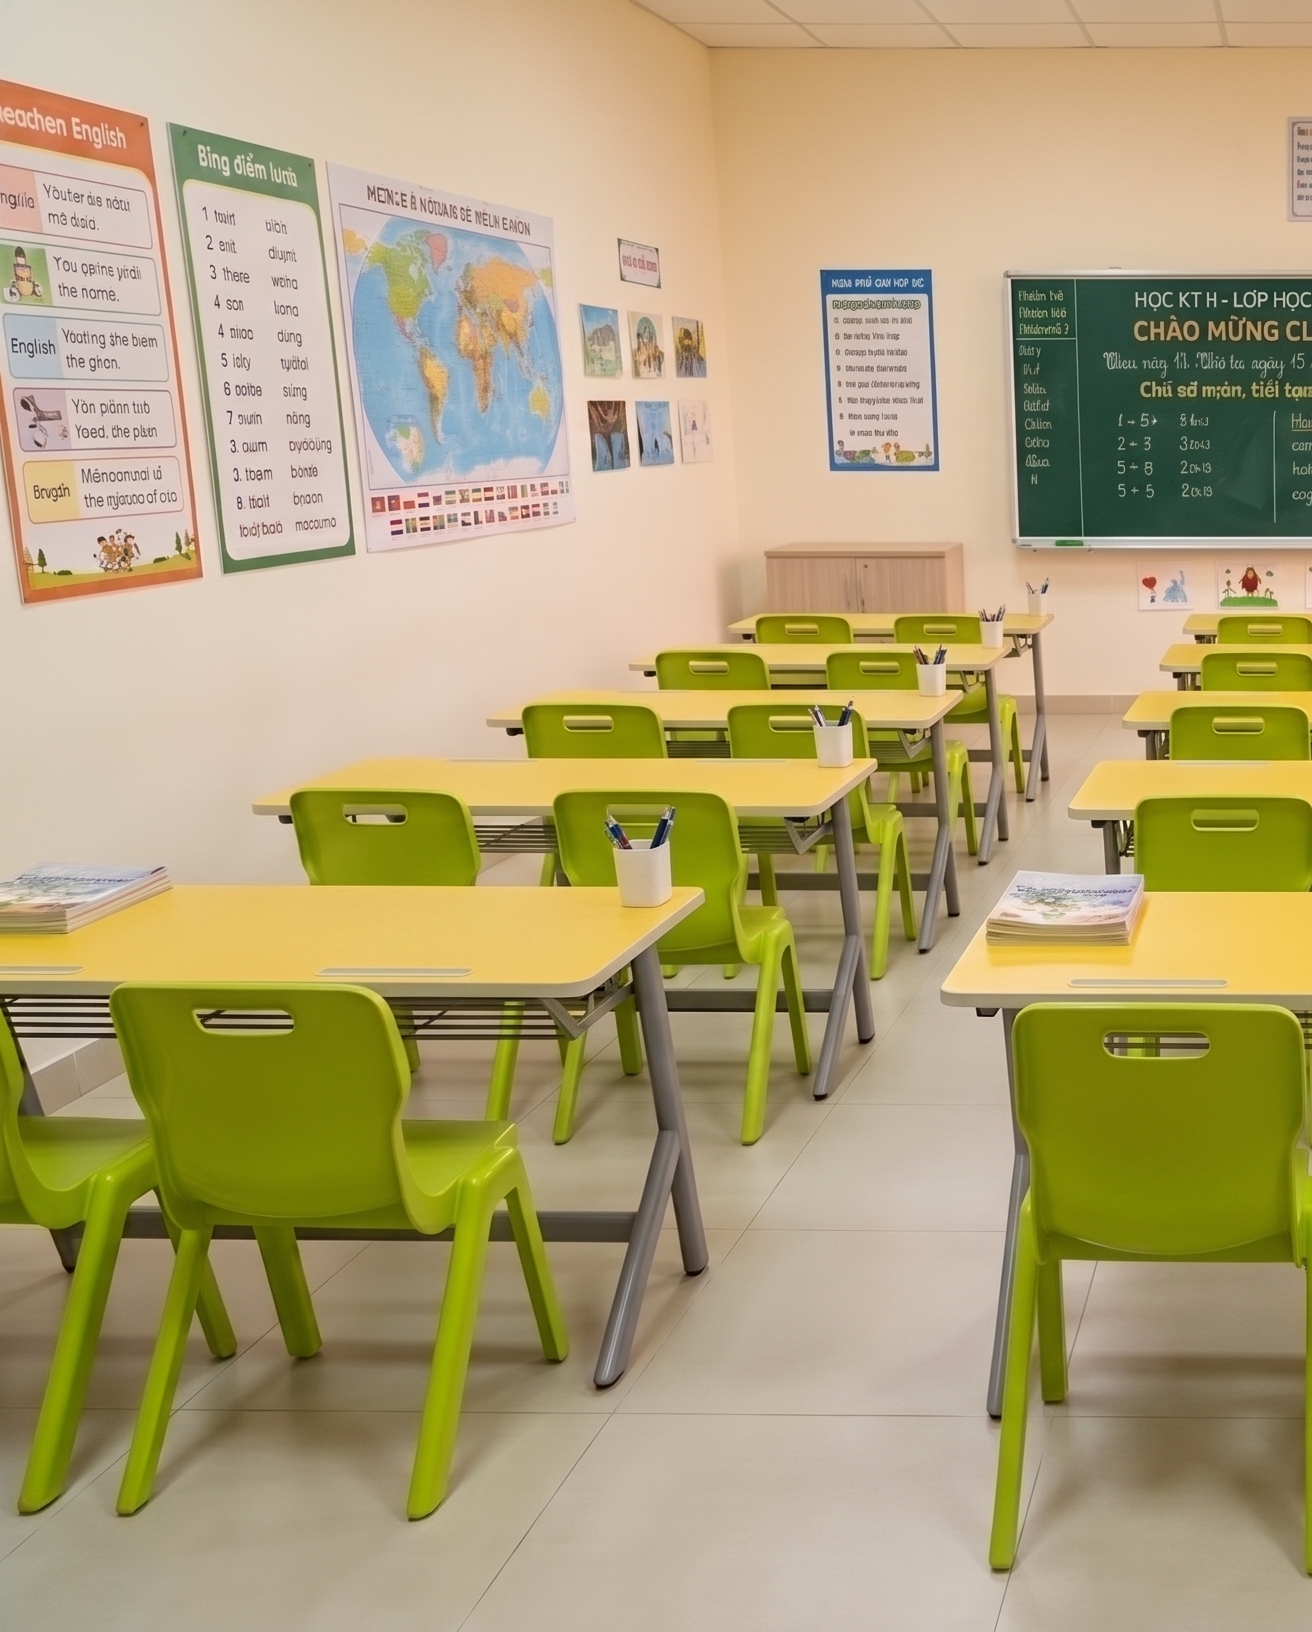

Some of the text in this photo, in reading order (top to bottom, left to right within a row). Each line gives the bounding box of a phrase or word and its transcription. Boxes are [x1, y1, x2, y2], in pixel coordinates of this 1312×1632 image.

[0, 105, 127, 149] eachen English
[197, 144, 231, 177] Bing
[202, 206, 208, 221] 1
[205, 234, 214, 250] 2
[53, 256, 78, 272] You
[209, 264, 217, 280] 3
[58, 283, 78, 298] the
[213, 294, 221, 309] 4
[226, 298, 245, 312] son
[1134, 291, 1174, 312] HỌC
[1273, 291, 1312, 312] HỌC
[218, 323, 225, 338] 4
[1207, 315, 1280, 342] MỪNG
[11, 338, 56, 358] English
[66, 354, 86, 369] the
[221, 352, 228, 368] 5
[1290, 353, 1306, 370] 15
[223, 381, 231, 397] 6
[226, 410, 233, 425] 7
[1117, 436, 1126, 451] 2
[1144, 436, 1152, 451] 3
[1179, 435, 1188, 451] 3
[1117, 460, 1127, 475] 5
[1180, 460, 1189, 474] 2
[1117, 483, 1127, 498] 5
[1145, 484, 1155, 499] 5
[1181, 483, 1190, 498] 2
[84, 494, 104, 509] the
